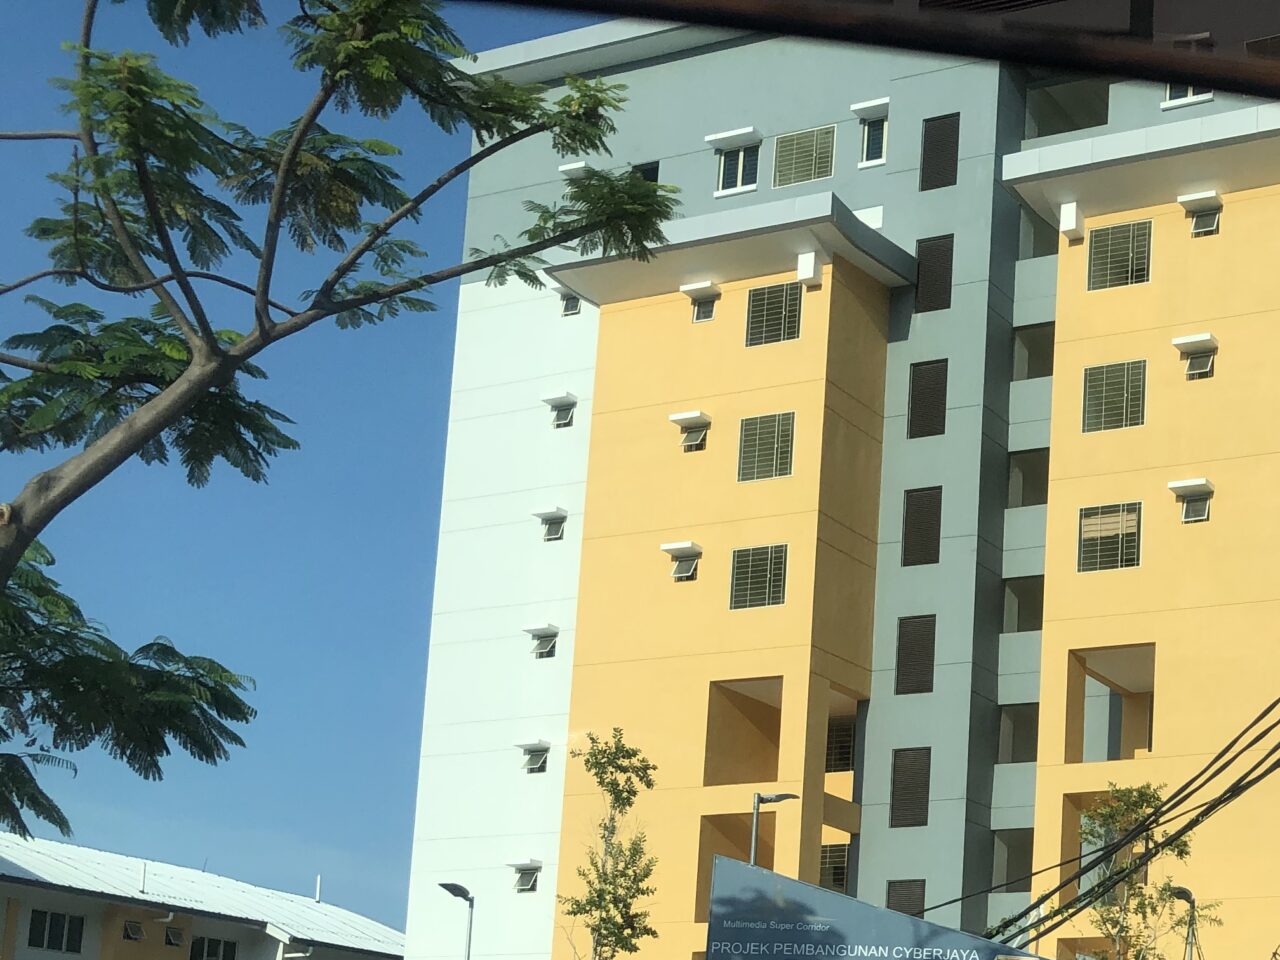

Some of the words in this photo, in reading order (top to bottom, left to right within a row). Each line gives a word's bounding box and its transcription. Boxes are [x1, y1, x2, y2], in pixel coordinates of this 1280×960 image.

[723, 920, 767, 929] Multimedia
[769, 921, 793, 931] Super
[796, 922, 830, 932] Corridor
[711, 941, 770, 955] PROJEK
[773, 942, 889, 958] PEMBANGUNAN
[892, 946, 980, 960] CYBERJAYA
